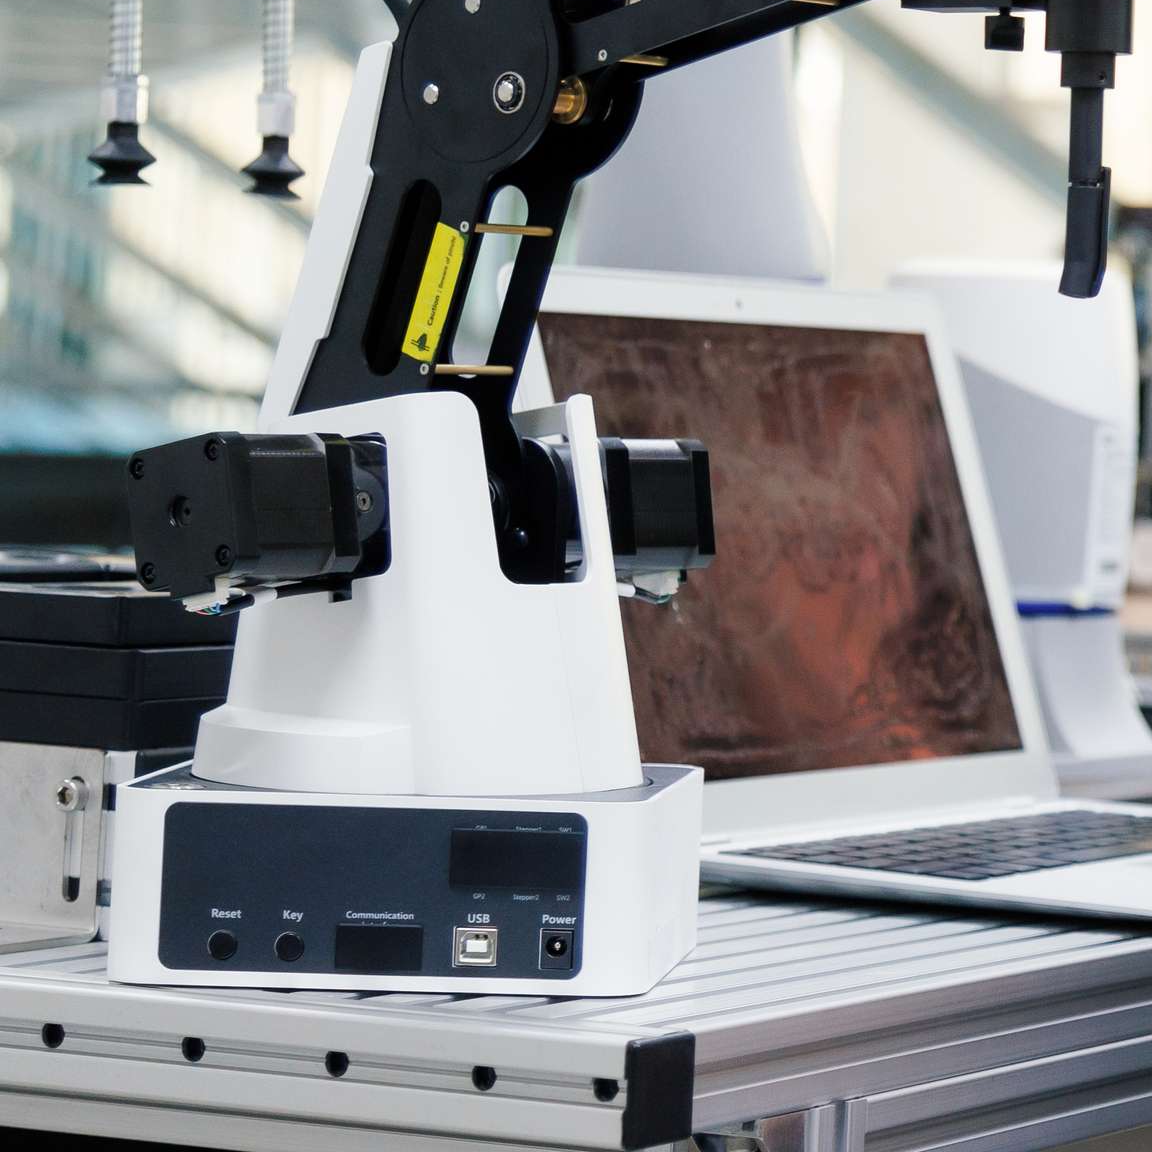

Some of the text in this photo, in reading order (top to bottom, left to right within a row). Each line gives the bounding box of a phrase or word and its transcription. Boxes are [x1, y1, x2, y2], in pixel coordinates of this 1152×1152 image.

[427, 295, 440, 326] Caution
[211, 908, 242, 919] Reset
[282, 909, 304, 923] Key
[345, 910, 415, 920] Communication
[467, 913, 490, 924] USB
[542, 914, 577, 925] Power
